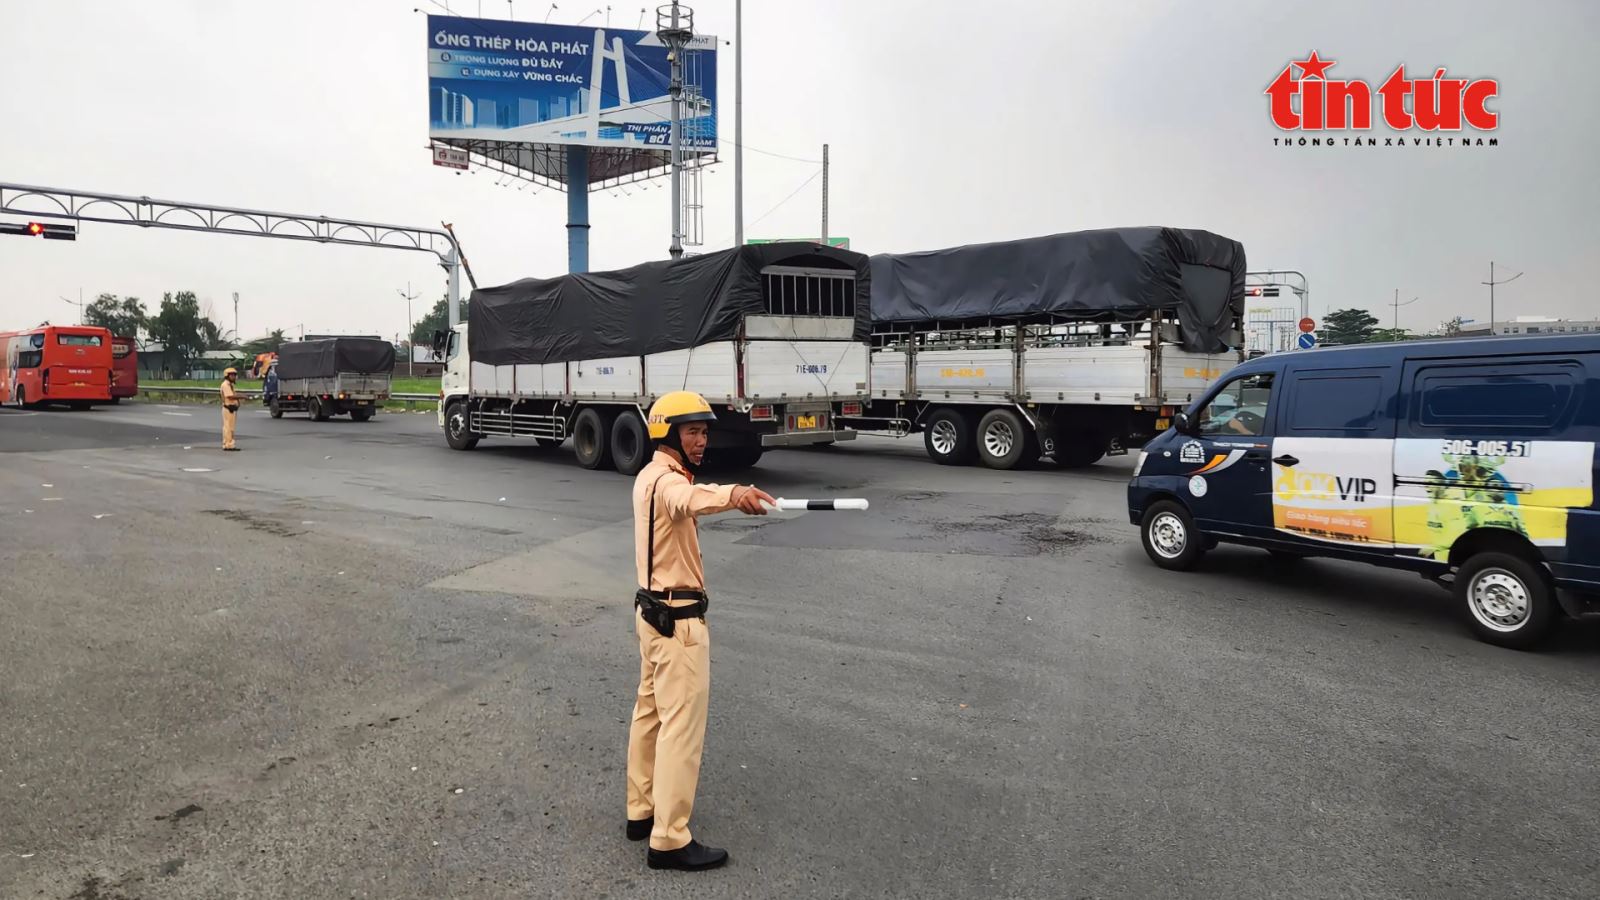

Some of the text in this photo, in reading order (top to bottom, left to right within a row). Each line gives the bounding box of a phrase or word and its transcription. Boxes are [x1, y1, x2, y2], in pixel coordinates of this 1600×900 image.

[434, 30, 589, 56] ỐNG THÉP HÒA PHÁT
[1442, 439, 1531, 457] 50G-005.51
